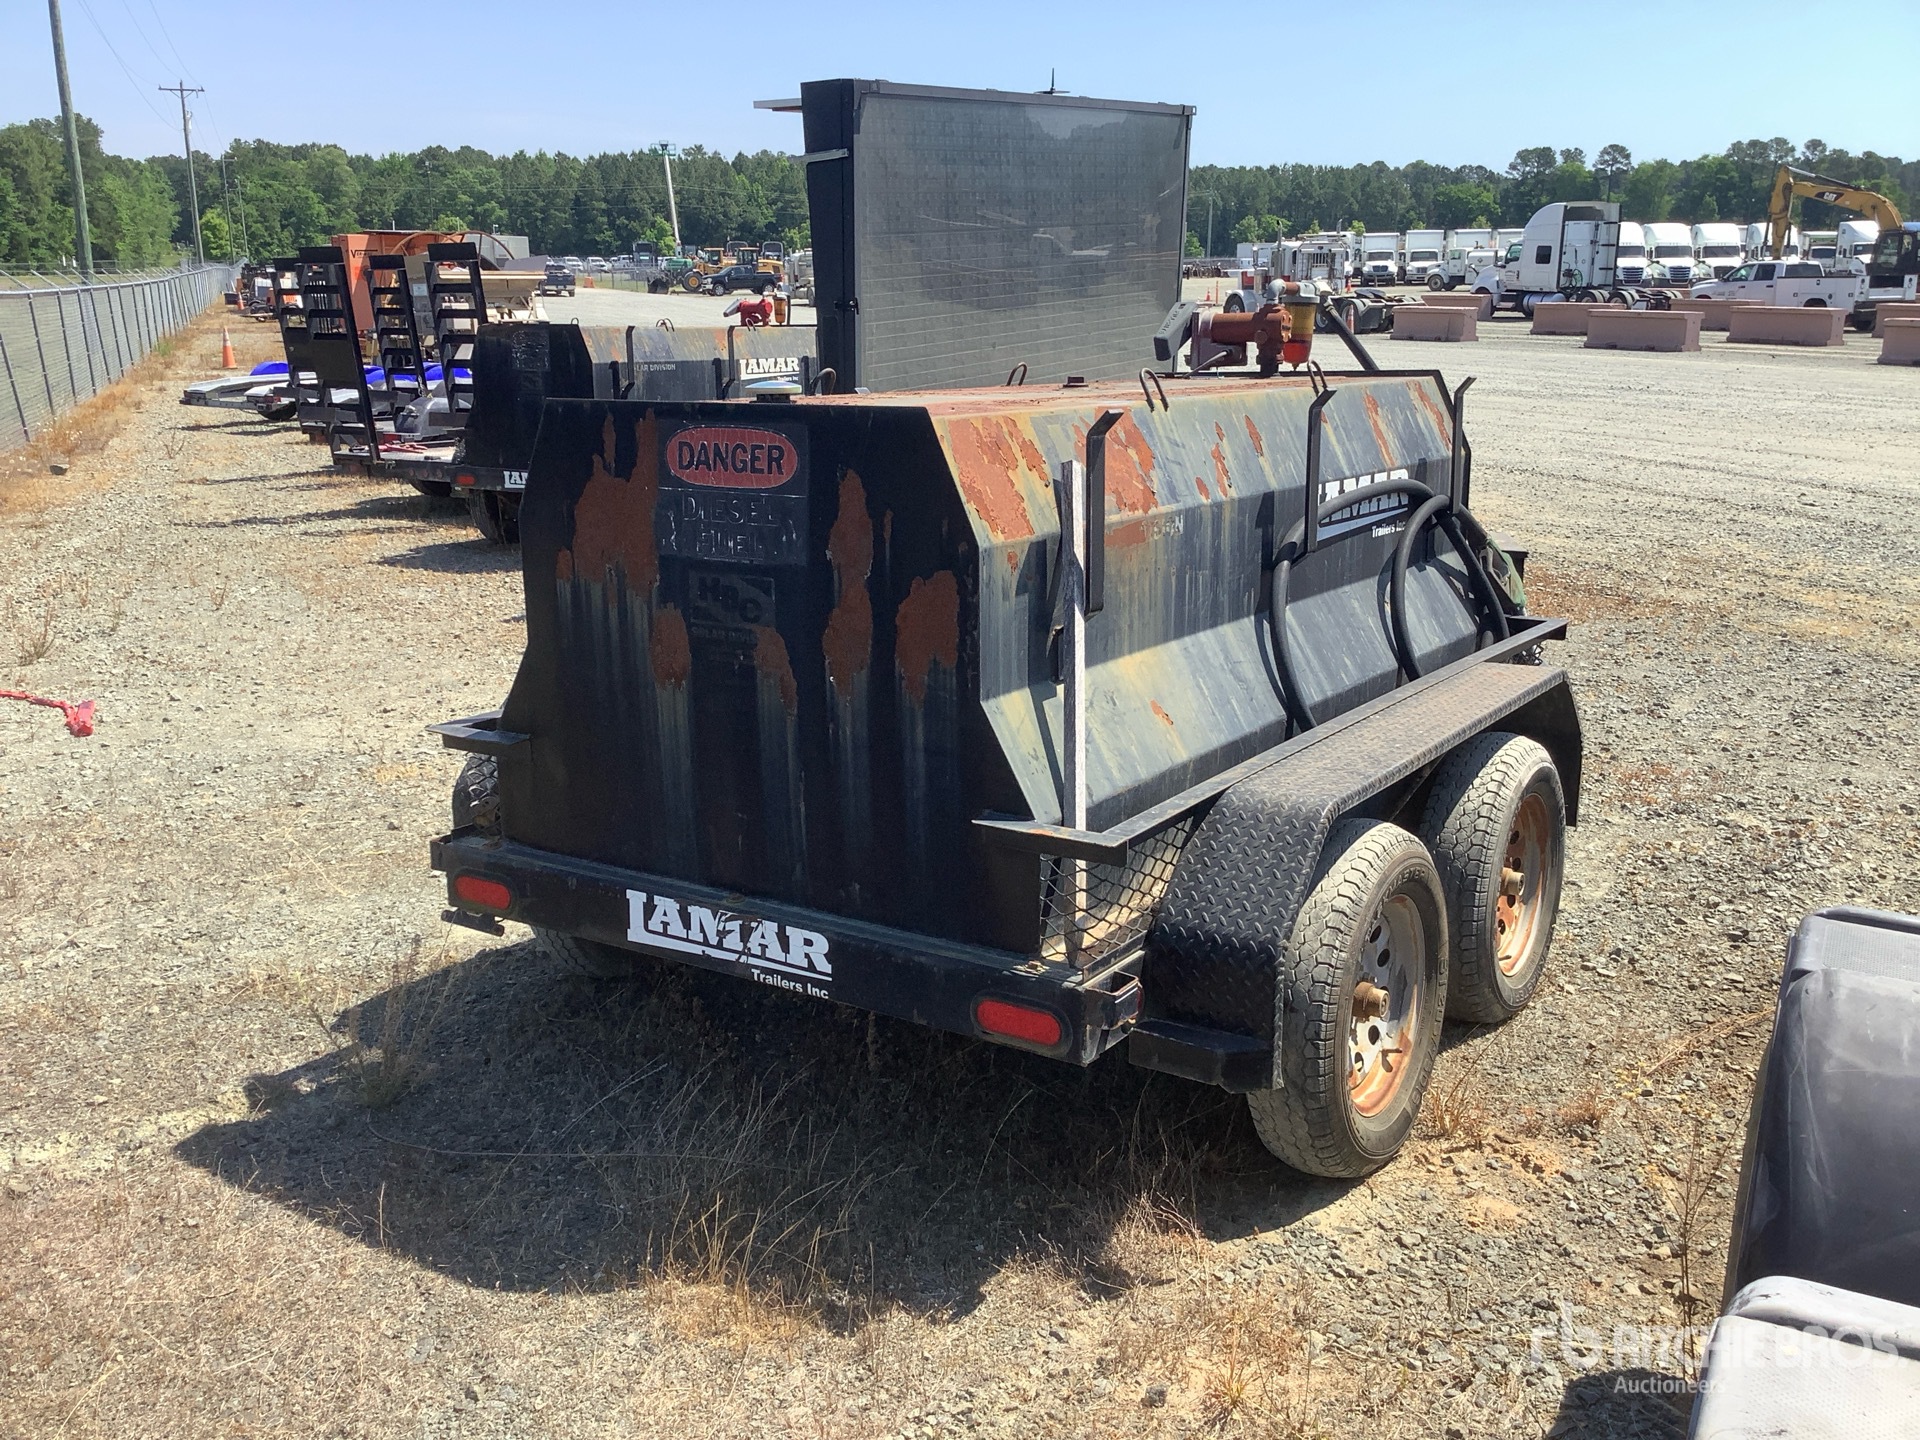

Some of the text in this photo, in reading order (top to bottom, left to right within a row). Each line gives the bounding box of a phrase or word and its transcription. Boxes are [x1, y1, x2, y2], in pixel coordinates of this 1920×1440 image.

[740, 357, 800, 380] LAMAR
[677, 440, 786, 476] DANGER
[682, 493, 780, 527] DIESEL
[697, 528, 765, 562] FUEL
[1371, 523, 1395, 538] Trailers
[626, 889, 832, 979] LAMAR
[751, 968, 829, 999] Trailers Inc
